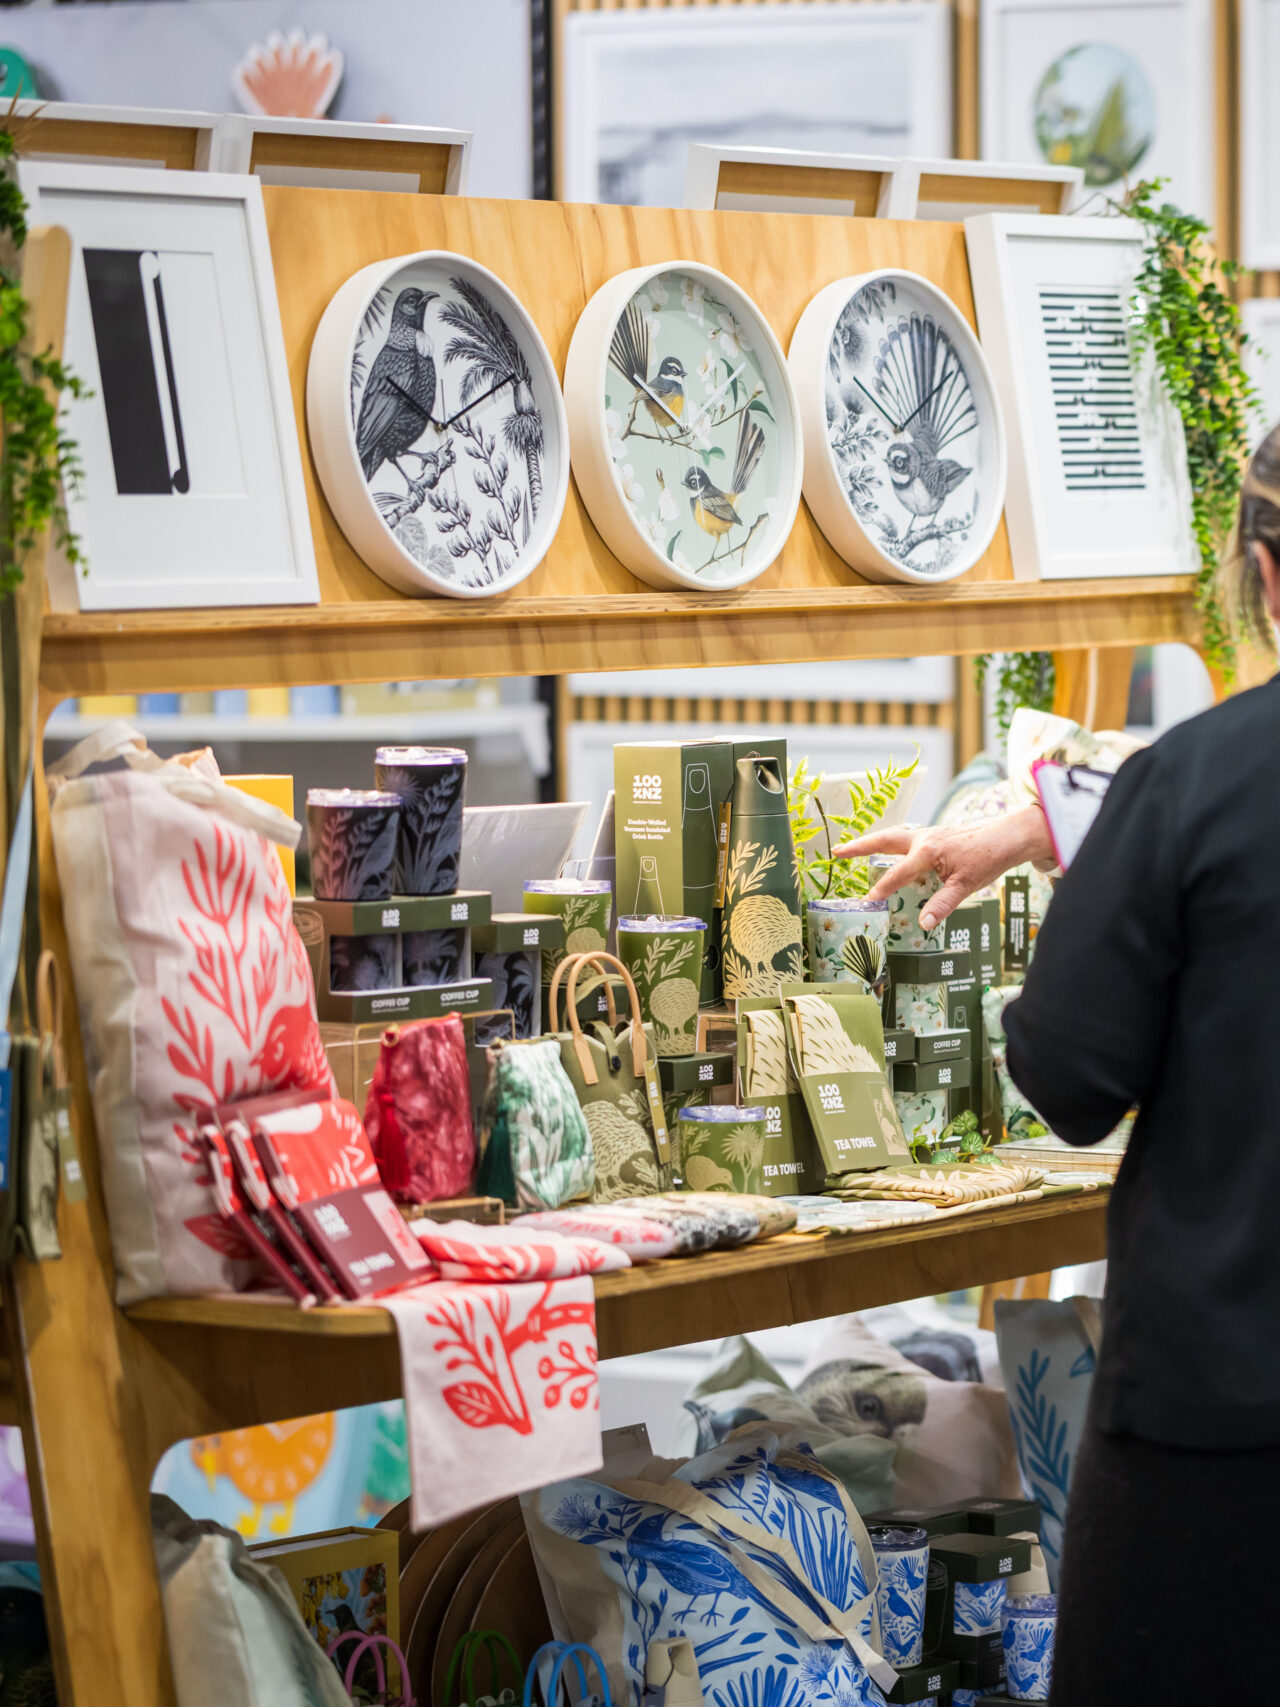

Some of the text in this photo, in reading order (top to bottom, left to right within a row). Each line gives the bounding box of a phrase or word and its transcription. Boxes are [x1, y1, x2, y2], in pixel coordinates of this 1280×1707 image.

[632, 774, 662, 788] 100
[523, 928, 539, 938] 100
[950, 928, 970, 943] 100
[941, 960, 954, 969] 100
[441, 989, 480, 1001] COFFEE CUP
[371, 996, 411, 1008] COFFEE CUP
[934, 1040, 950, 1049] COFFEE
[699, 1064, 713, 1074] 100
[938, 1067, 952, 1077] 100
[818, 1083, 840, 1098] 100
[765, 1106, 781, 1120] 00
[765, 1119, 782, 1134] NZ
[834, 1136, 877, 1151] TEA TOWEL
[763, 1162, 805, 1177] TEA TOWEL
[999, 1557, 1012, 1566] 100
[928, 1675, 941, 1684] 100
